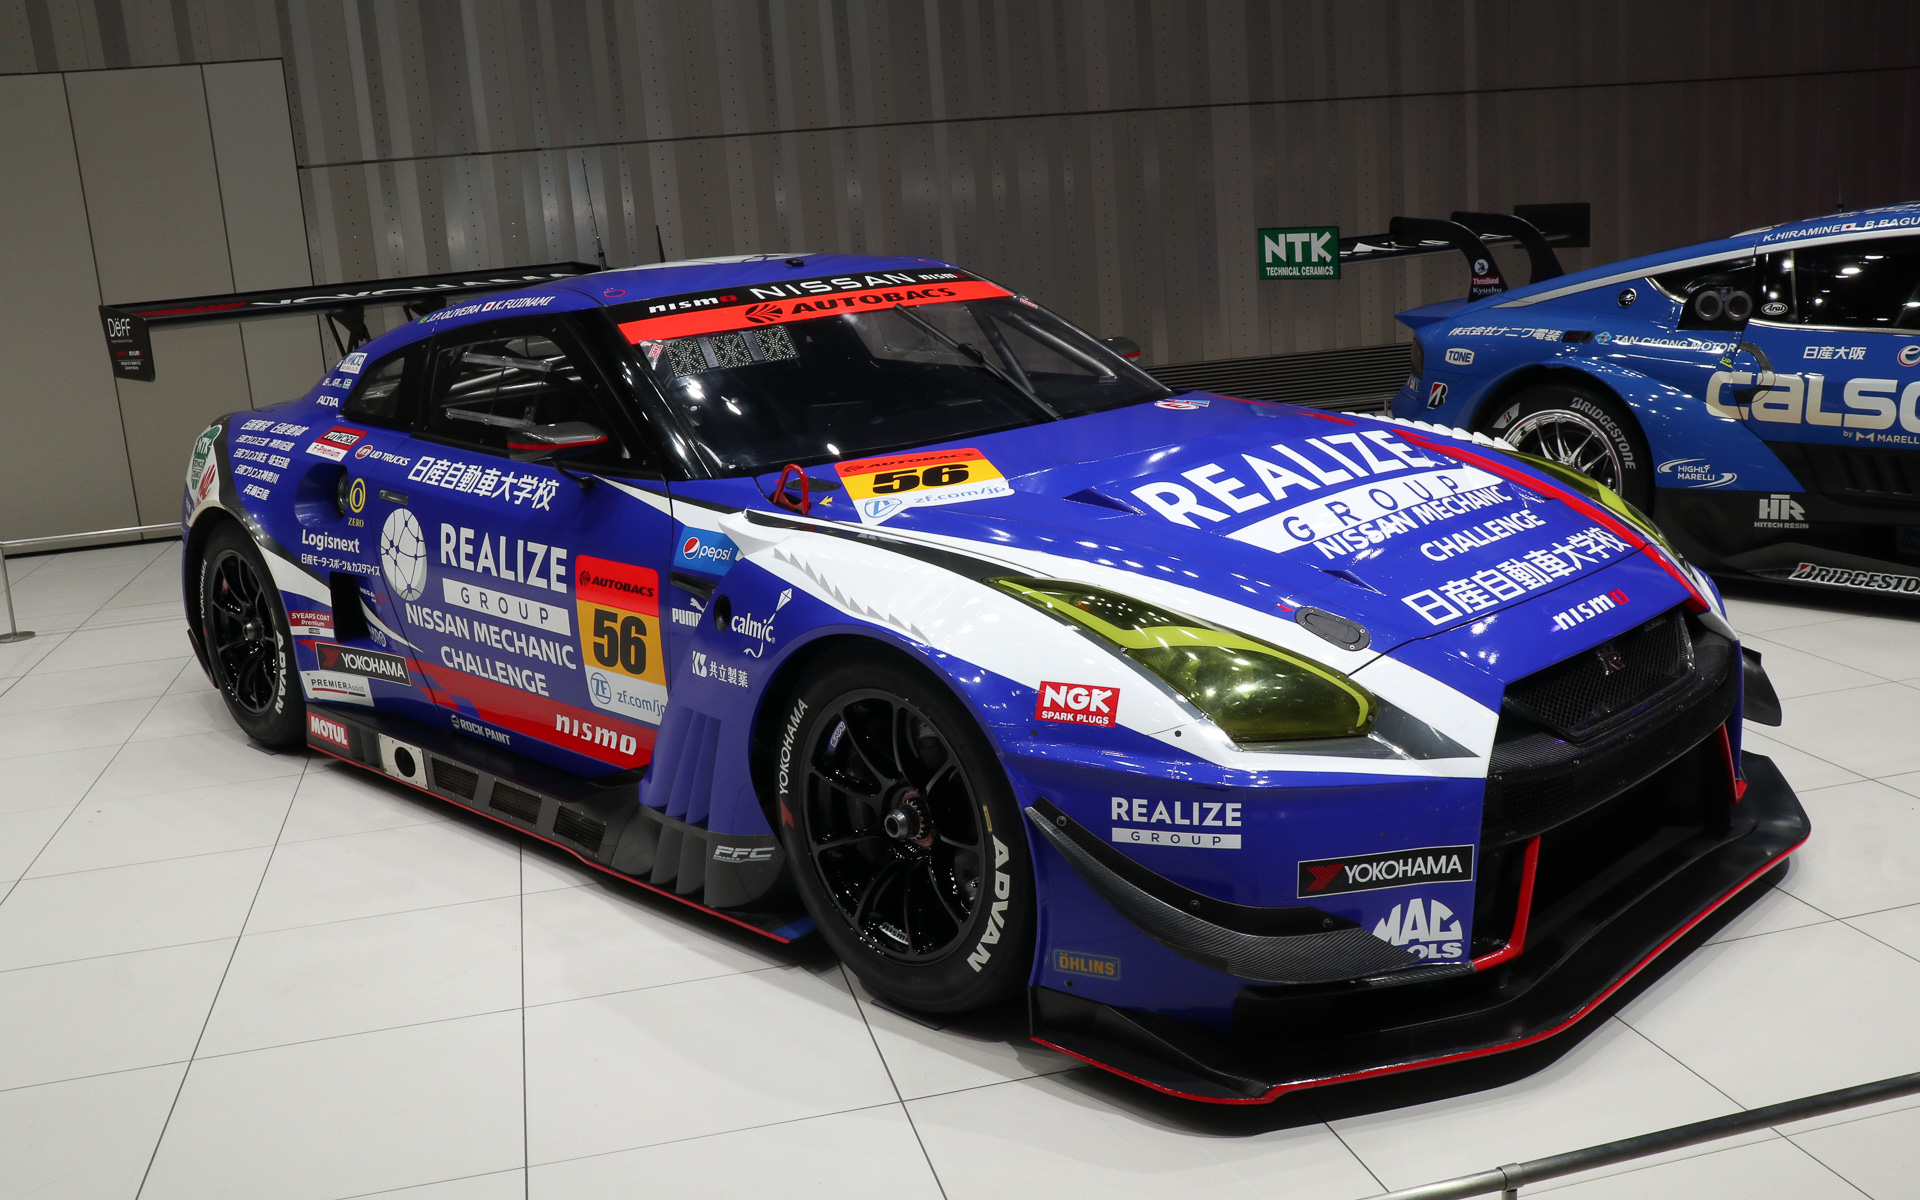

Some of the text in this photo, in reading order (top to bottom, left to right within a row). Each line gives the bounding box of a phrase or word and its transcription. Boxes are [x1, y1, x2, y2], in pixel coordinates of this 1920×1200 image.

[1264, 231, 1332, 263] NTK
[1762, 225, 1843, 243] K.HIRAMINE
[1266, 265, 1334, 276] TECHNICAL CERAMICS
[648, 294, 738, 314] nismo
[749, 271, 917, 300] NISSAN
[790, 287, 957, 315] AUTOBACS
[1472, 287, 1502, 295] Kyushu
[426, 296, 556, 322] J.P.OLIVEIRA K.FUJINAMI
[1764, 303, 1784, 312] Arai
[107, 318, 131, 337] Dëff
[1448, 326, 1563, 342] 株式会社ナニワ電装
[1448, 350, 1472, 363] TONE
[1615, 334, 1738, 353] TAN CHONG MOTOR
[1802, 346, 1867, 361] 日産大阪
[316, 395, 339, 408] ALTIA
[1569, 397, 1636, 470] BRIDGESTONE
[1843, 430, 1853, 439] by
[369, 450, 411, 466] UD TRUCKS
[864, 452, 976, 469] AUTOBACS
[1677, 464, 1711, 473] HIGHLY
[407, 455, 560, 512] 日産自動車大学校
[872, 463, 969, 494] 56
[1130, 430, 1436, 530] REALIZE
[1677, 472, 1716, 482] MARELLI
[914, 486, 1006, 504] zf.com/jp
[1282, 474, 1459, 542] GROUP
[348, 517, 364, 528] ZERO
[1313, 485, 1513, 560] NISSAN MECHANIC
[1420, 509, 1547, 562] CHALLENGE
[1754, 521, 1809, 530] HITECH RESIN
[301, 529, 360, 554] Logisnext
[699, 545, 733, 562] pepsi
[440, 522, 568, 594] REALIZE
[592, 576, 655, 597] AUTOBACS
[1400, 526, 1633, 627] 日産自動車大学校
[292, 612, 331, 622] 5YEARS COAT
[460, 586, 549, 625] GROUP
[1552, 589, 1630, 631] nismo
[301, 619, 325, 627] Premium
[405, 602, 470, 640] NISSAN
[473, 620, 578, 670] MECHANIC
[731, 612, 775, 644] calmic
[593, 608, 647, 675] 56
[274, 630, 288, 715] ADVAN
[340, 652, 406, 679] YOKOHAMA
[440, 645, 550, 697] CHALLENGE
[709, 661, 749, 688] 共立製薬
[1042, 684, 1113, 714] NGK
[310, 716, 348, 745] MOTUL
[1041, 710, 1109, 725] SPARK PLUGS
[460, 718, 511, 746] ROCK PAINT
[556, 713, 637, 756] nismo
[778, 698, 809, 795] YOKOHAMA
[1111, 796, 1242, 827] REALIZE
[714, 845, 776, 859] PFC
[1130, 831, 1222, 846] GROUP
[1343, 854, 1464, 884] YOKOHAMA
[966, 834, 1012, 973] ADVAN
[1372, 897, 1463, 947] MAC
[1058, 951, 1116, 977] ÖHLINS
[1406, 941, 1463, 960] OLS
